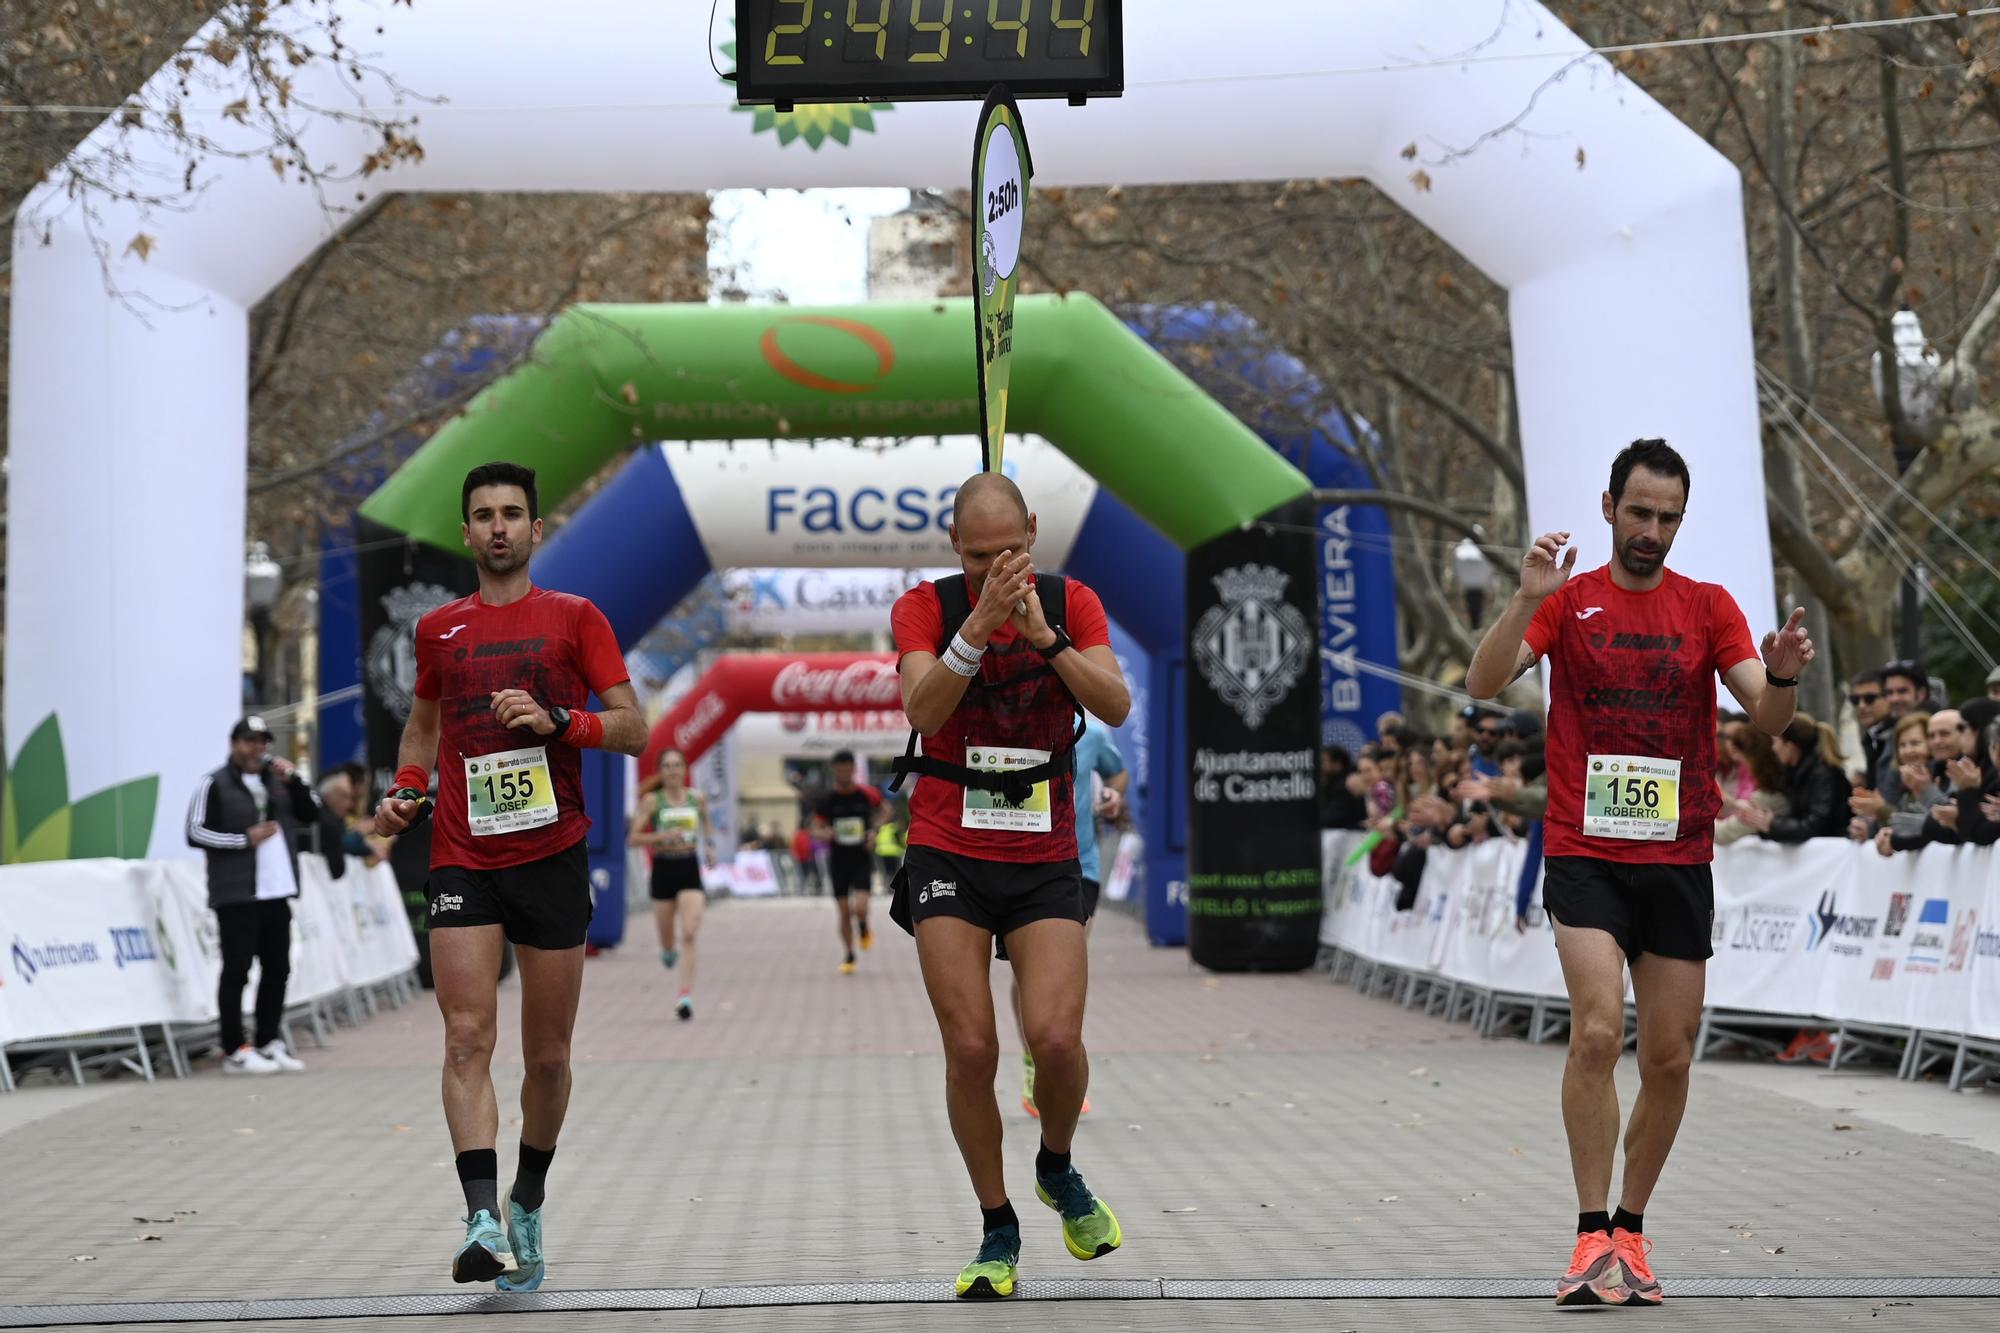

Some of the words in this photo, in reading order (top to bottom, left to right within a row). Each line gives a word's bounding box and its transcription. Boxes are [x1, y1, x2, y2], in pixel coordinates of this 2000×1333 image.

[764, 0, 1094, 65] 2:49:44
[988, 177, 1018, 224] 2:50h
[1323, 504, 1362, 713] BAVIERA
[1194, 747, 1314, 778] Ajuntament
[484, 770, 534, 803] 155
[1194, 776, 1220, 802] de
[1607, 777, 1659, 808] 156
[493, 799, 528, 814] JOSEP
[1604, 806, 1660, 819] ROBERTO
